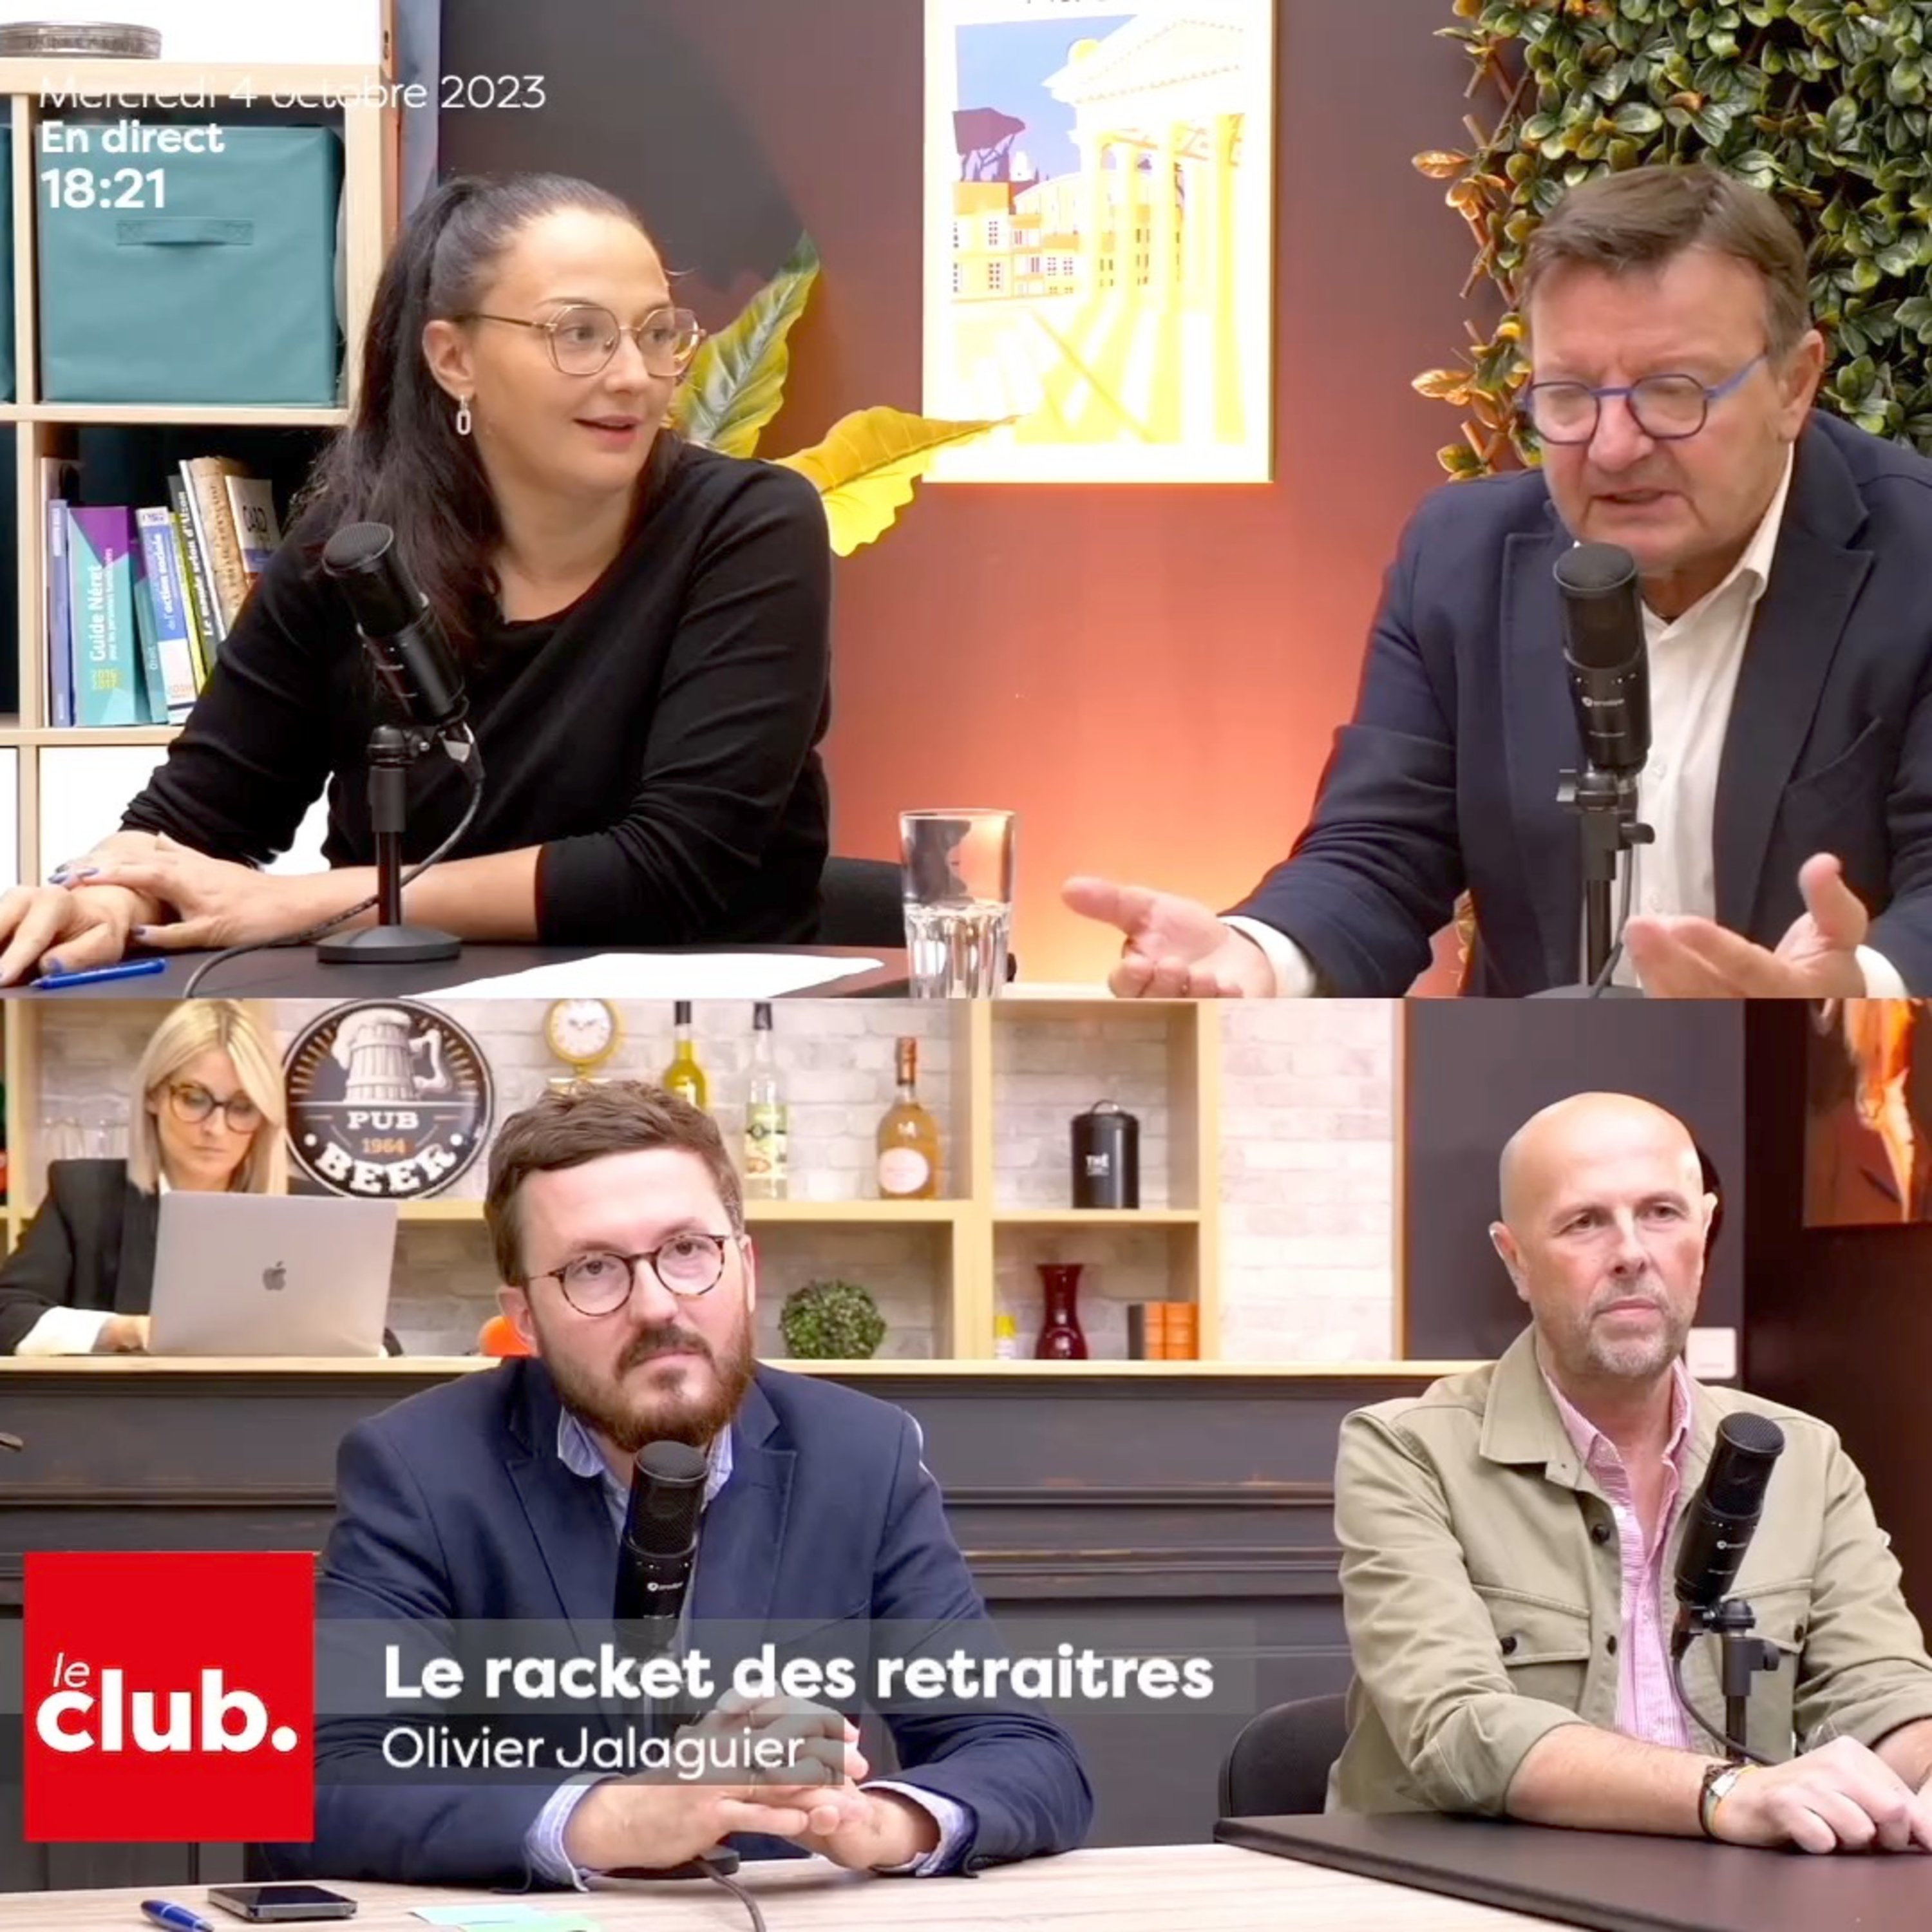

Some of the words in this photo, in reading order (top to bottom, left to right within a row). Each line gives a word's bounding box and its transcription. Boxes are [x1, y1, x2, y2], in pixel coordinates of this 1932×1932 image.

[87, 564, 104, 610] Néret
[88, 614, 106, 661] Guide
[346, 1110, 420, 1130] PUB
[314, 1142, 458, 1193] BEER
